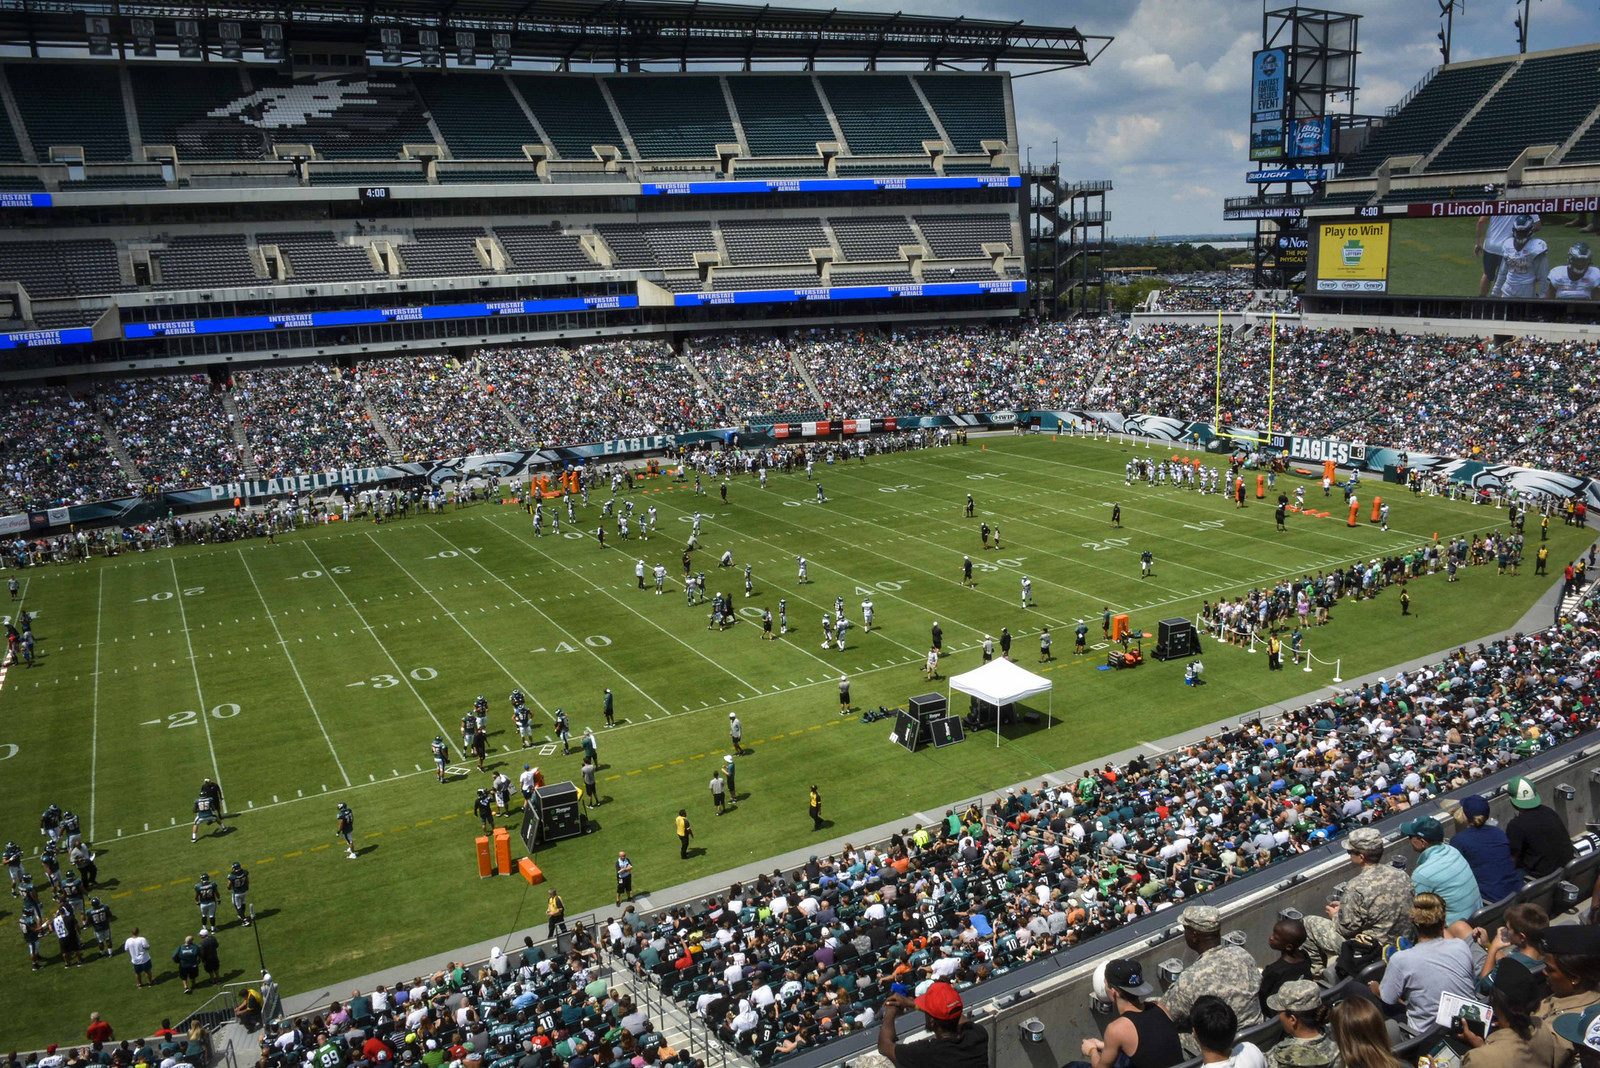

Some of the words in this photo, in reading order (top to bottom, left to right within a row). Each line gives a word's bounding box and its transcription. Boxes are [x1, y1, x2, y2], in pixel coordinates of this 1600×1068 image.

[1258, 99, 1279, 110] EVENT
[366, 188, 386, 198] 4:00
[1360, 206, 1379, 216] 4:00
[1447, 201, 1493, 215] Lincoln
[1497, 199, 1558, 214] Financial
[1563, 197, 1598, 212] Field
[1239, 209, 1265, 218] TRAINING
[1264, 208, 1284, 217] CAMP
[1284, 208, 1301, 217] PRES
[1324, 226, 1346, 239] Play
[1348, 226, 1358, 236] to
[1360, 225, 1384, 236] Win!
[268, 313, 313, 323] INTERSTATE
[381, 307, 422, 316] INTERSTATE
[396, 313, 423, 321] AERIALS
[148, 320, 196, 331] INTERSTATE
[284, 319, 314, 328] AERIALS
[9, 330, 61, 342] INTERSTATE
[164, 327, 197, 336] AERIALS
[27, 337, 62, 347] AERIALS
[603, 434, 677, 456] EAGLES
[1291, 437, 1349, 465] EAGLES
[210, 468, 380, 500] PHILADELPHIA
[855, 580, 903, 596] 40
[554, 634, 613, 653] 40
[370, 666, 438, 689] 30
[167, 702, 242, 729] 20
[1005, 938, 1018, 952] 10
[484, 1006, 492, 1019] 7
[539, 1014, 555, 1031] 18
[497, 1033, 513, 1045] 20
[763, 1029, 771, 1042] 9
[320, 1049, 340, 1068] 99
